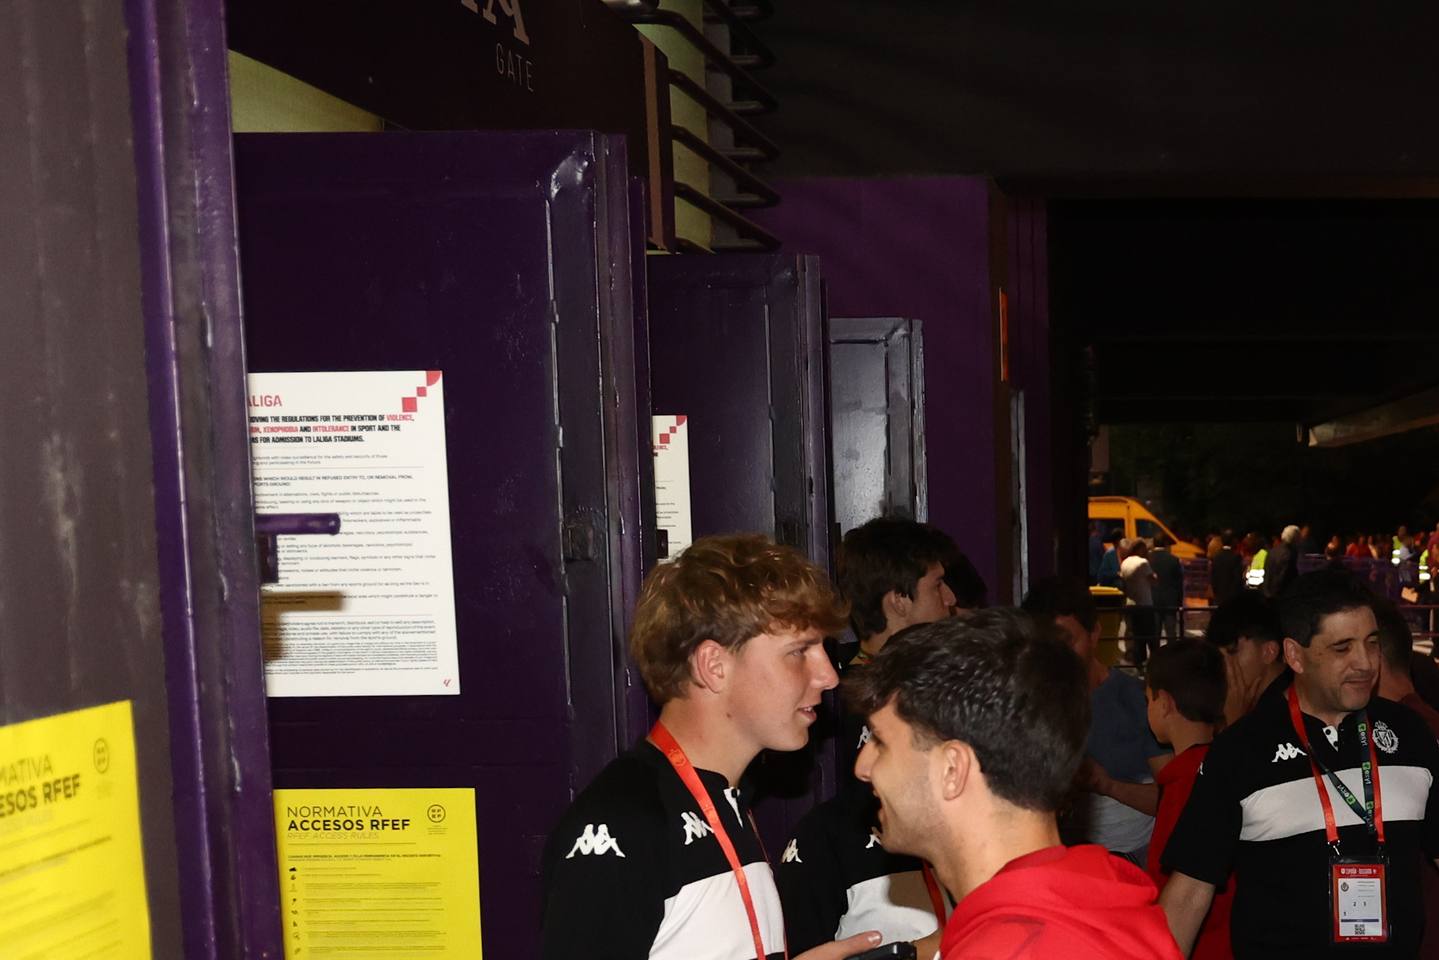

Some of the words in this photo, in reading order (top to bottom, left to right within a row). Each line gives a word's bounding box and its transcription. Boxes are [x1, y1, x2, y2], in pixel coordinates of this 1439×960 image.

[496, 42, 534, 92] GATE
[248, 394, 283, 408] LIGA
[270, 415, 281, 423] THE
[300, 425, 312, 433] AND
[358, 424, 377, 432] SPORT
[378, 424, 390, 432] AND
[391, 424, 401, 432] THE
[260, 436, 271, 444] FOR
[305, 435, 312, 443] TO
[42, 773, 80, 804] RFEF
[287, 805, 383, 818] NORMATIVA
[287, 819, 365, 831] ACCESOS
[370, 818, 411, 831] RFEF
